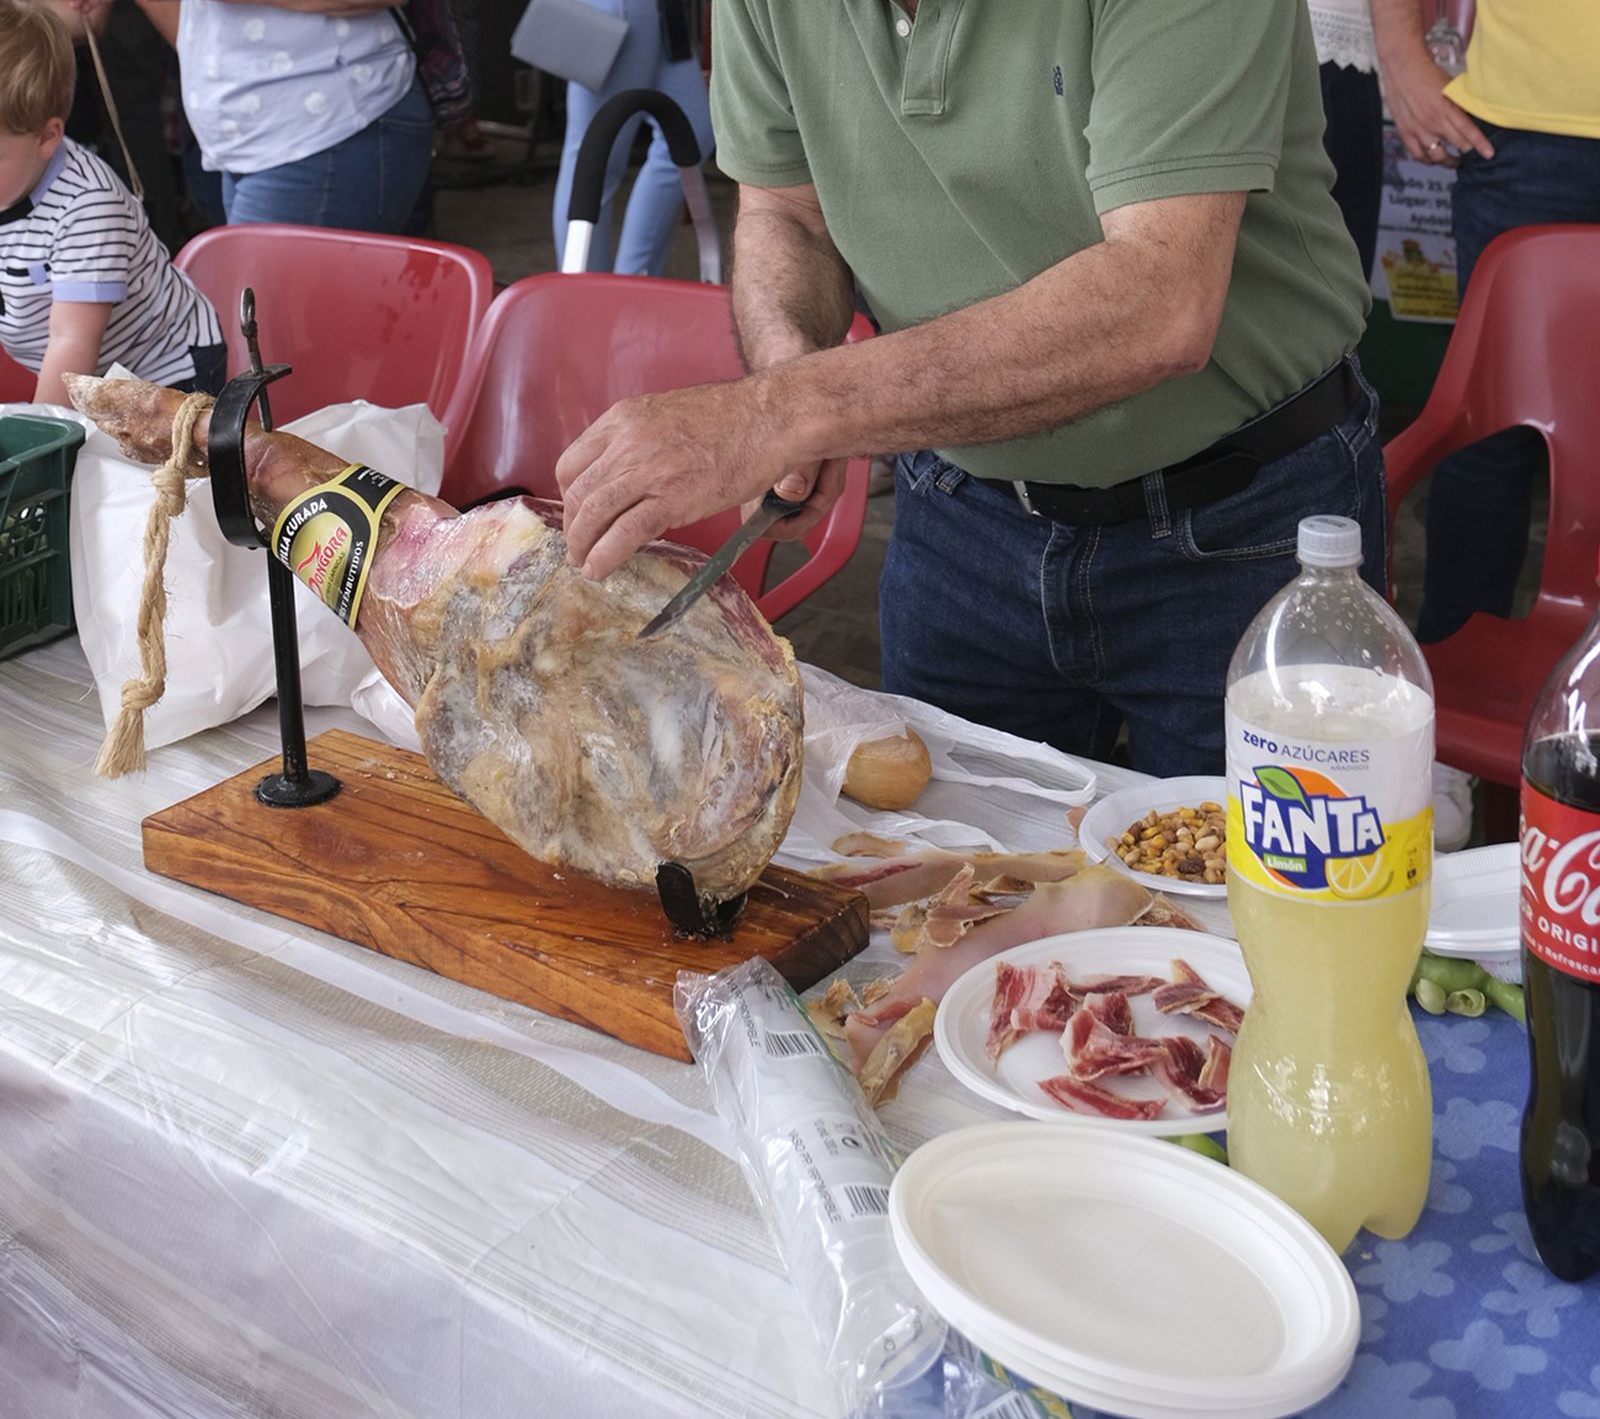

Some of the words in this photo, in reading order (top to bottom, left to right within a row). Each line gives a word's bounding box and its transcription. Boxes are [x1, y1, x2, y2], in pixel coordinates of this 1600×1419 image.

[286, 498, 328, 536] CURADA
[1243, 729, 1278, 754] zero
[1281, 744, 1370, 764] AZÚCARES
[1266, 857, 1304, 873] Limón
[1545, 946, 1600, 976] Refresca
